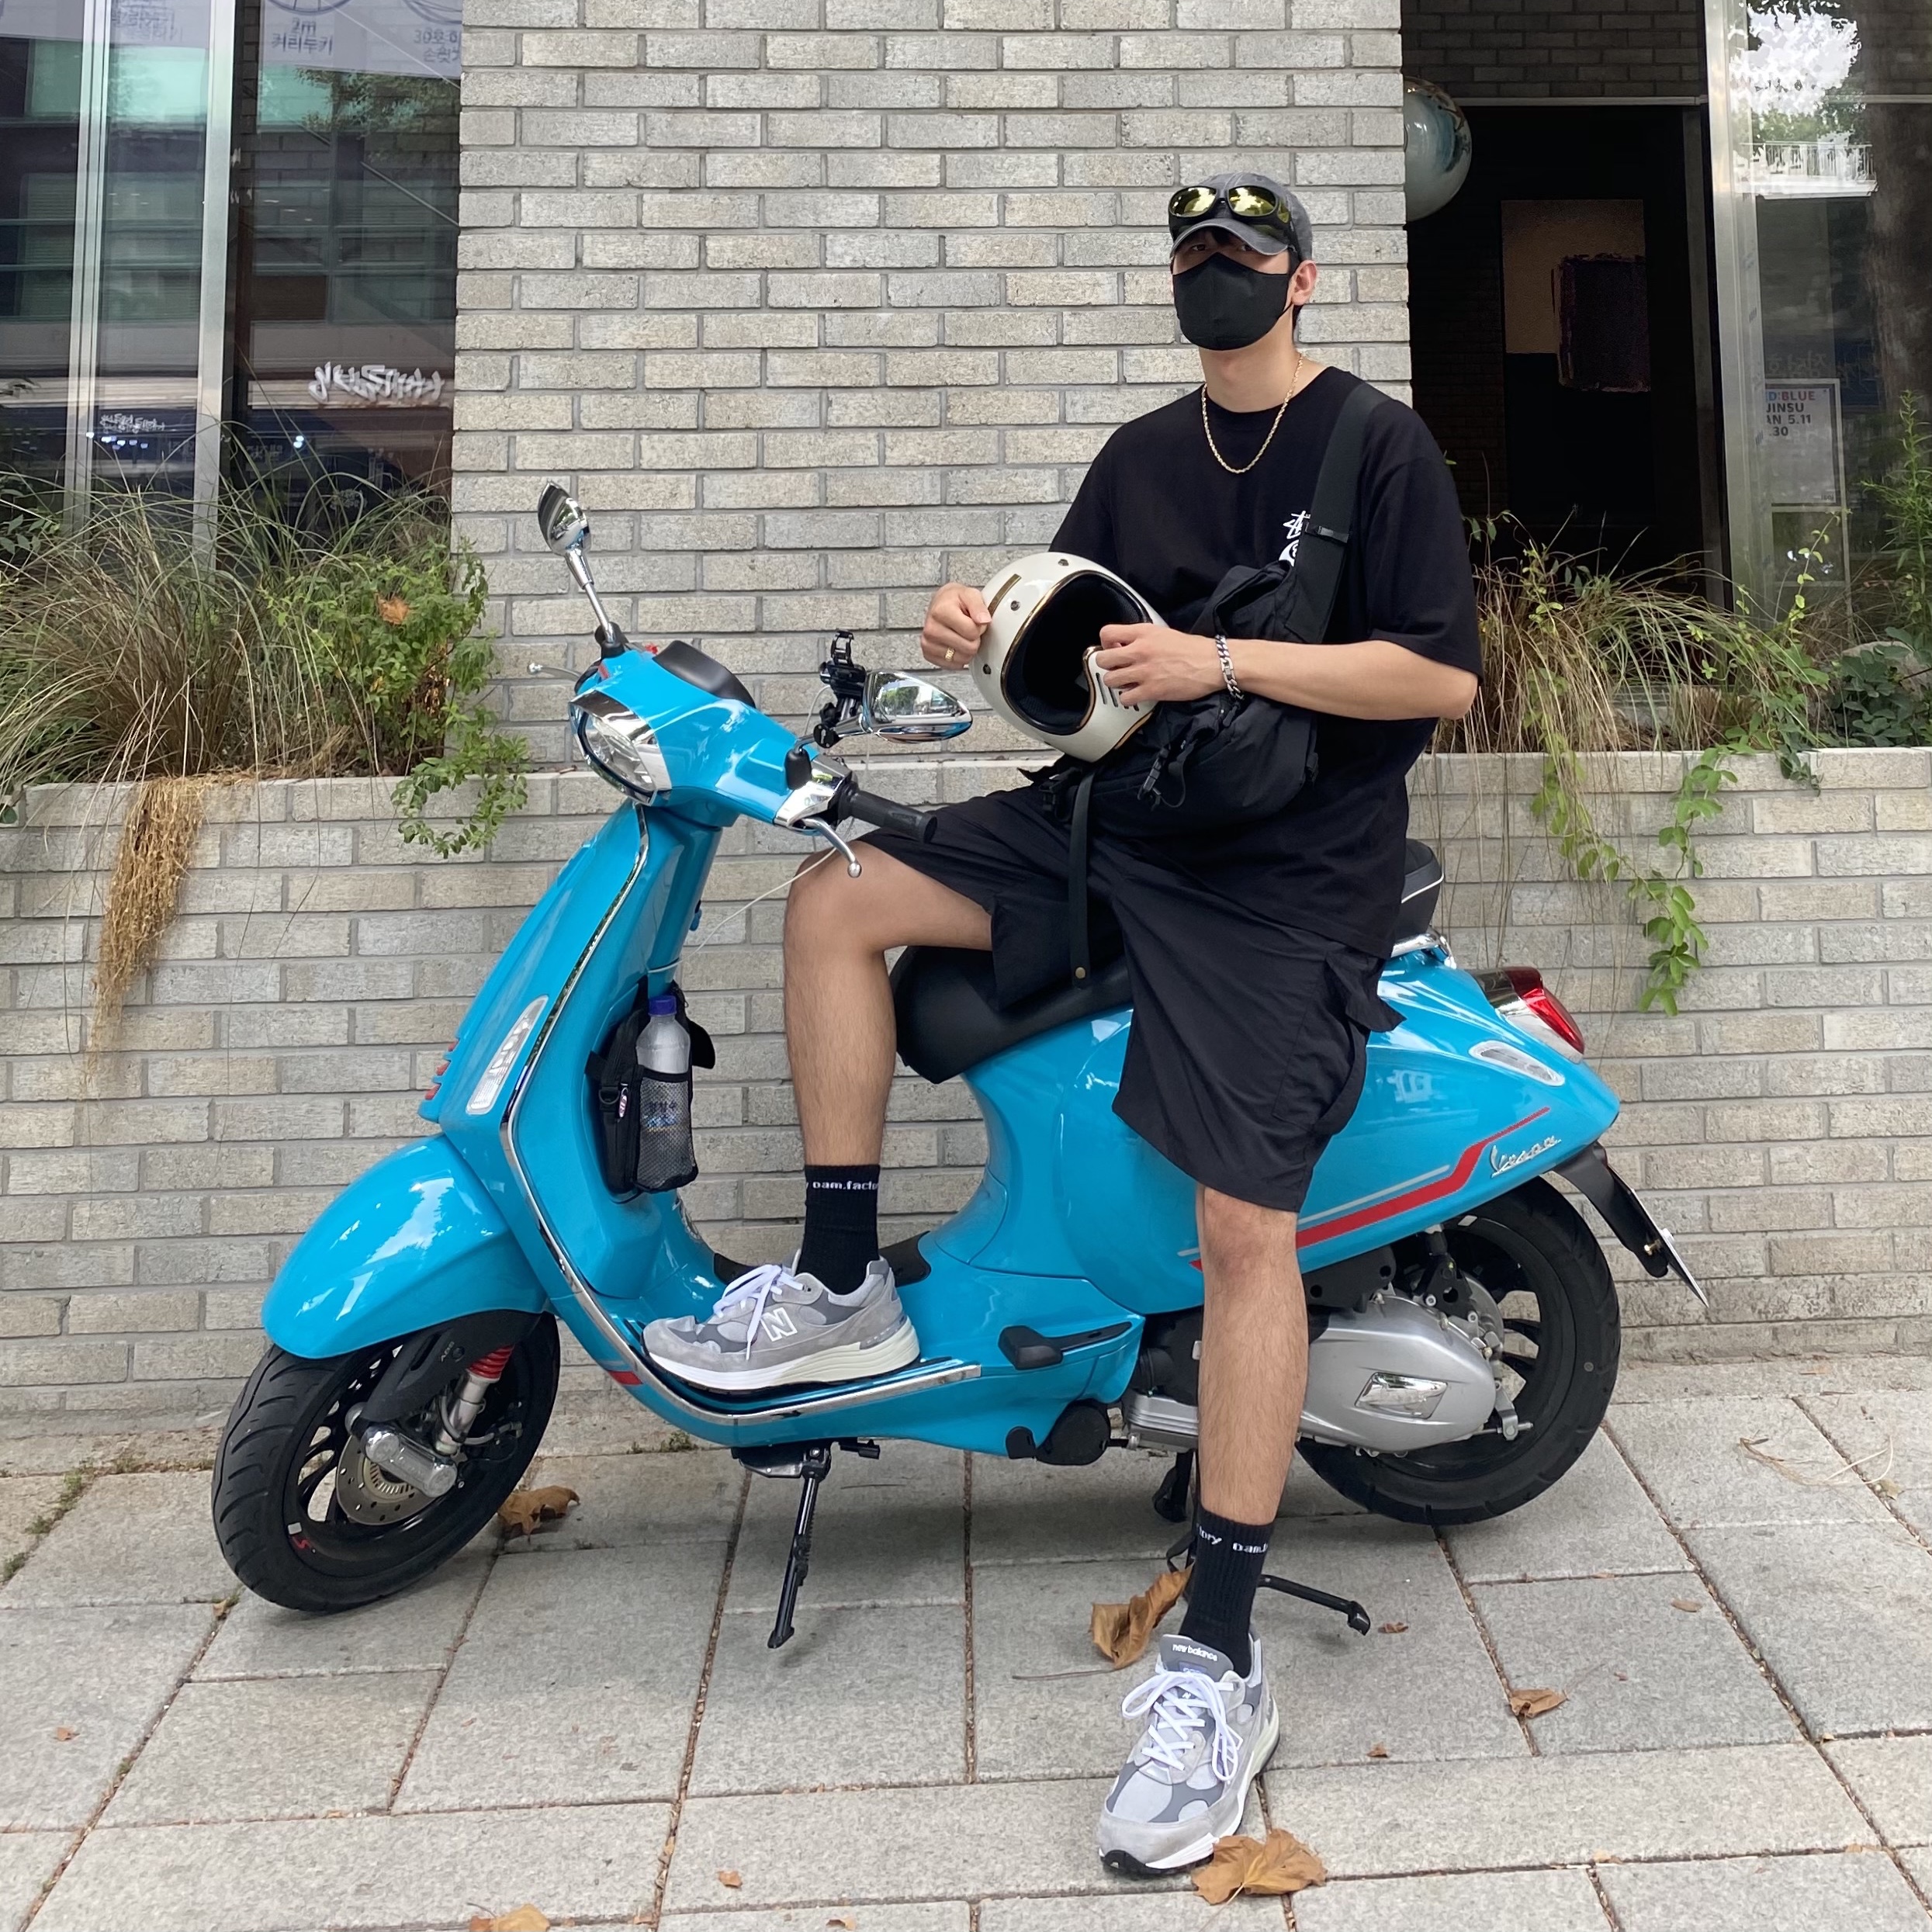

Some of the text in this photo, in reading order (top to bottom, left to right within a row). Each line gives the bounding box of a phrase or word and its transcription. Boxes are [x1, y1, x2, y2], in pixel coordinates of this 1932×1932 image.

[1765, 390, 1816, 401] D:BLUE
[1766, 402, 1805, 413] JINSU
[1788, 414, 1812, 424] 5.11
[760, 1307, 798, 1342] N
[1172, 1643, 1218, 1662] new balance
